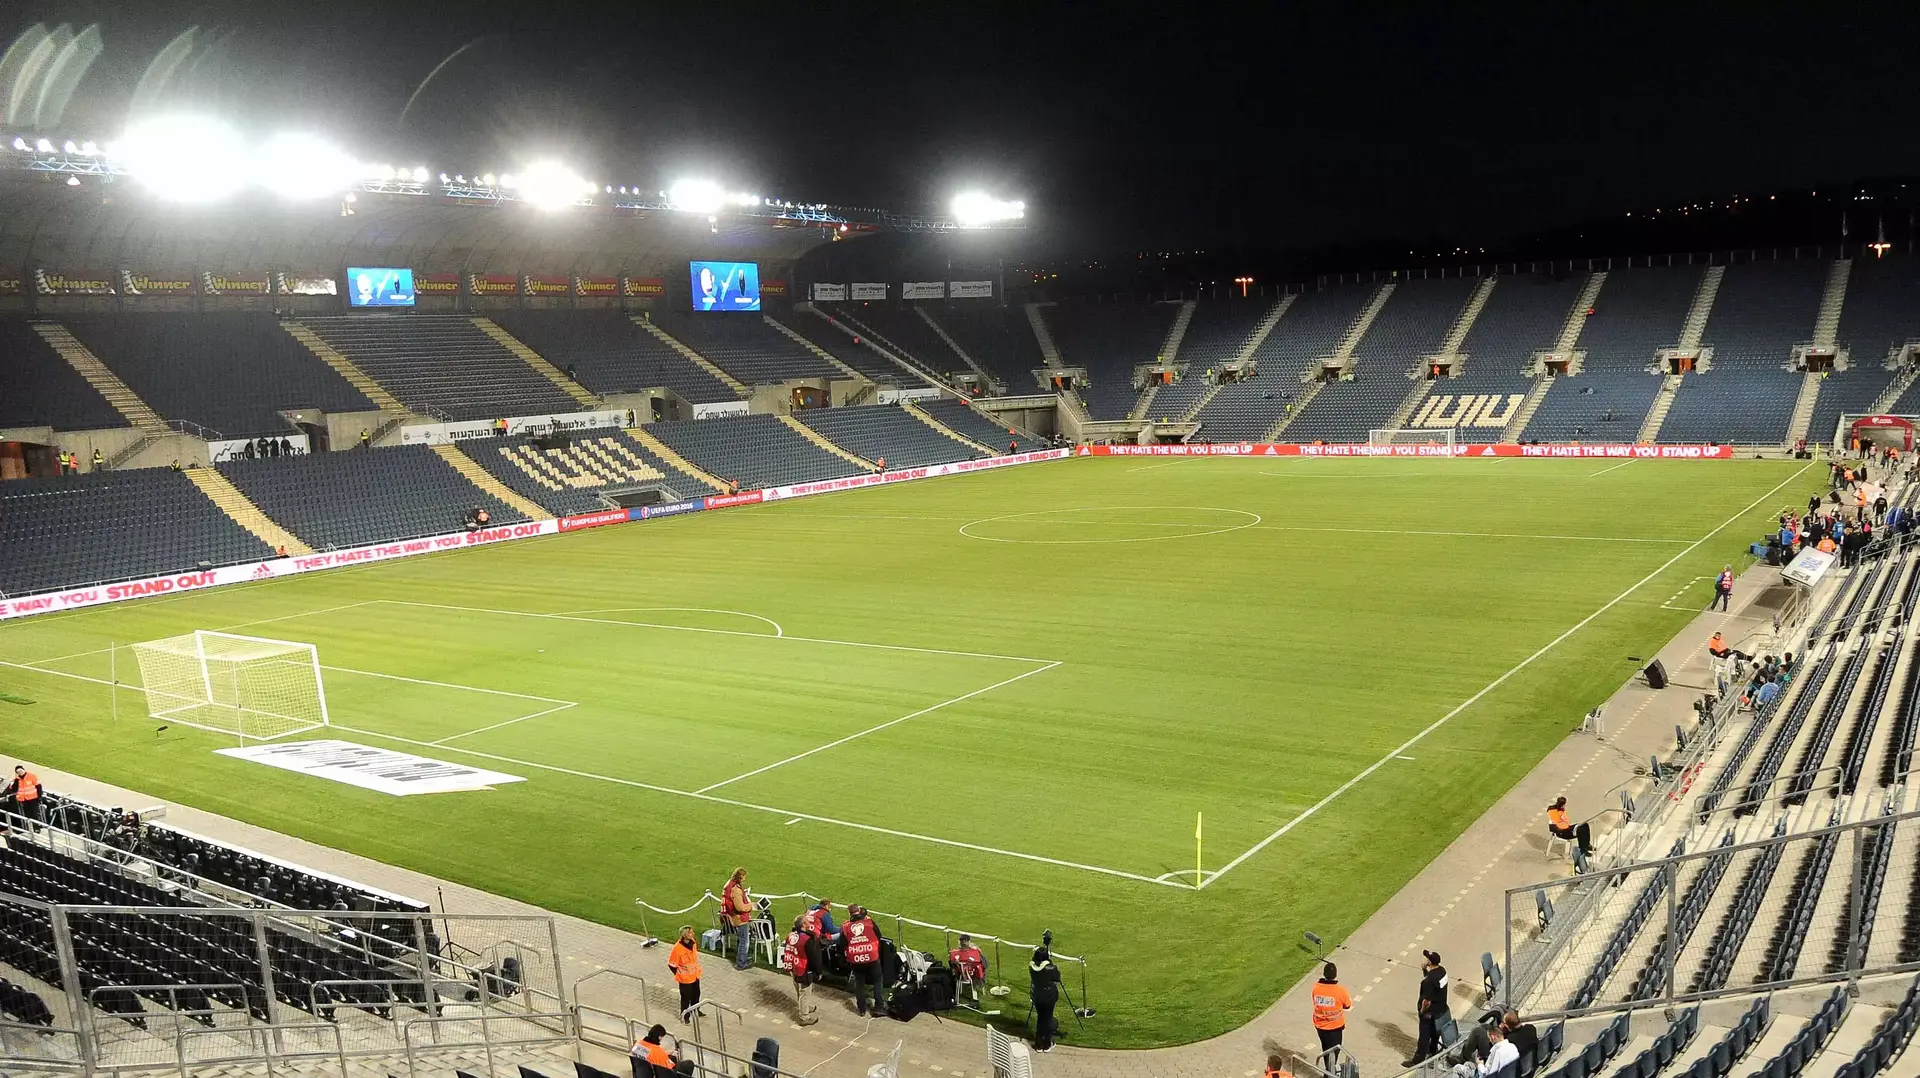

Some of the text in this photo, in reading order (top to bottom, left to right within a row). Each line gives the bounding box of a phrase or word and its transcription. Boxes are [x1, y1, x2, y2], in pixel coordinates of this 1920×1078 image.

[45, 275, 109, 289] Winner
[131, 276, 191, 290] Winner
[212, 276, 266, 290] Winner
[415, 278, 458, 291] Winner
[476, 279, 517, 291] Winner
[531, 280, 568, 292] Winner
[580, 280, 617, 291] Winner
[629, 282, 663, 292] Winner
[450, 429, 490, 438] השקעות
[1109, 445, 1253, 454] THEY HATE THE WAY YOU STAND UP
[1299, 445, 1468, 455] THEY HATE THE WAY YOU STAND UP
[1521, 446, 1720, 456] THEY HATE THE WAY YOU STAND UP
[1000, 457, 1015, 465] WAY
[1015, 455, 1026, 463] YOU
[1028, 452, 1048, 461] STAND
[1050, 450, 1062, 458] OUT
[791, 469, 928, 494] THEY HATE THE WAY YOU STAND OUT
[294, 523, 542, 569] THEY HATE THE WAY YOU STAND OUT
[12, 597, 53, 612] WAY
[60, 591, 98, 604] YOU
[106, 579, 173, 599] STAND
[177, 571, 217, 588] OUT
[849, 944, 873, 953] PHOTO
[854, 954, 870, 962] 065
